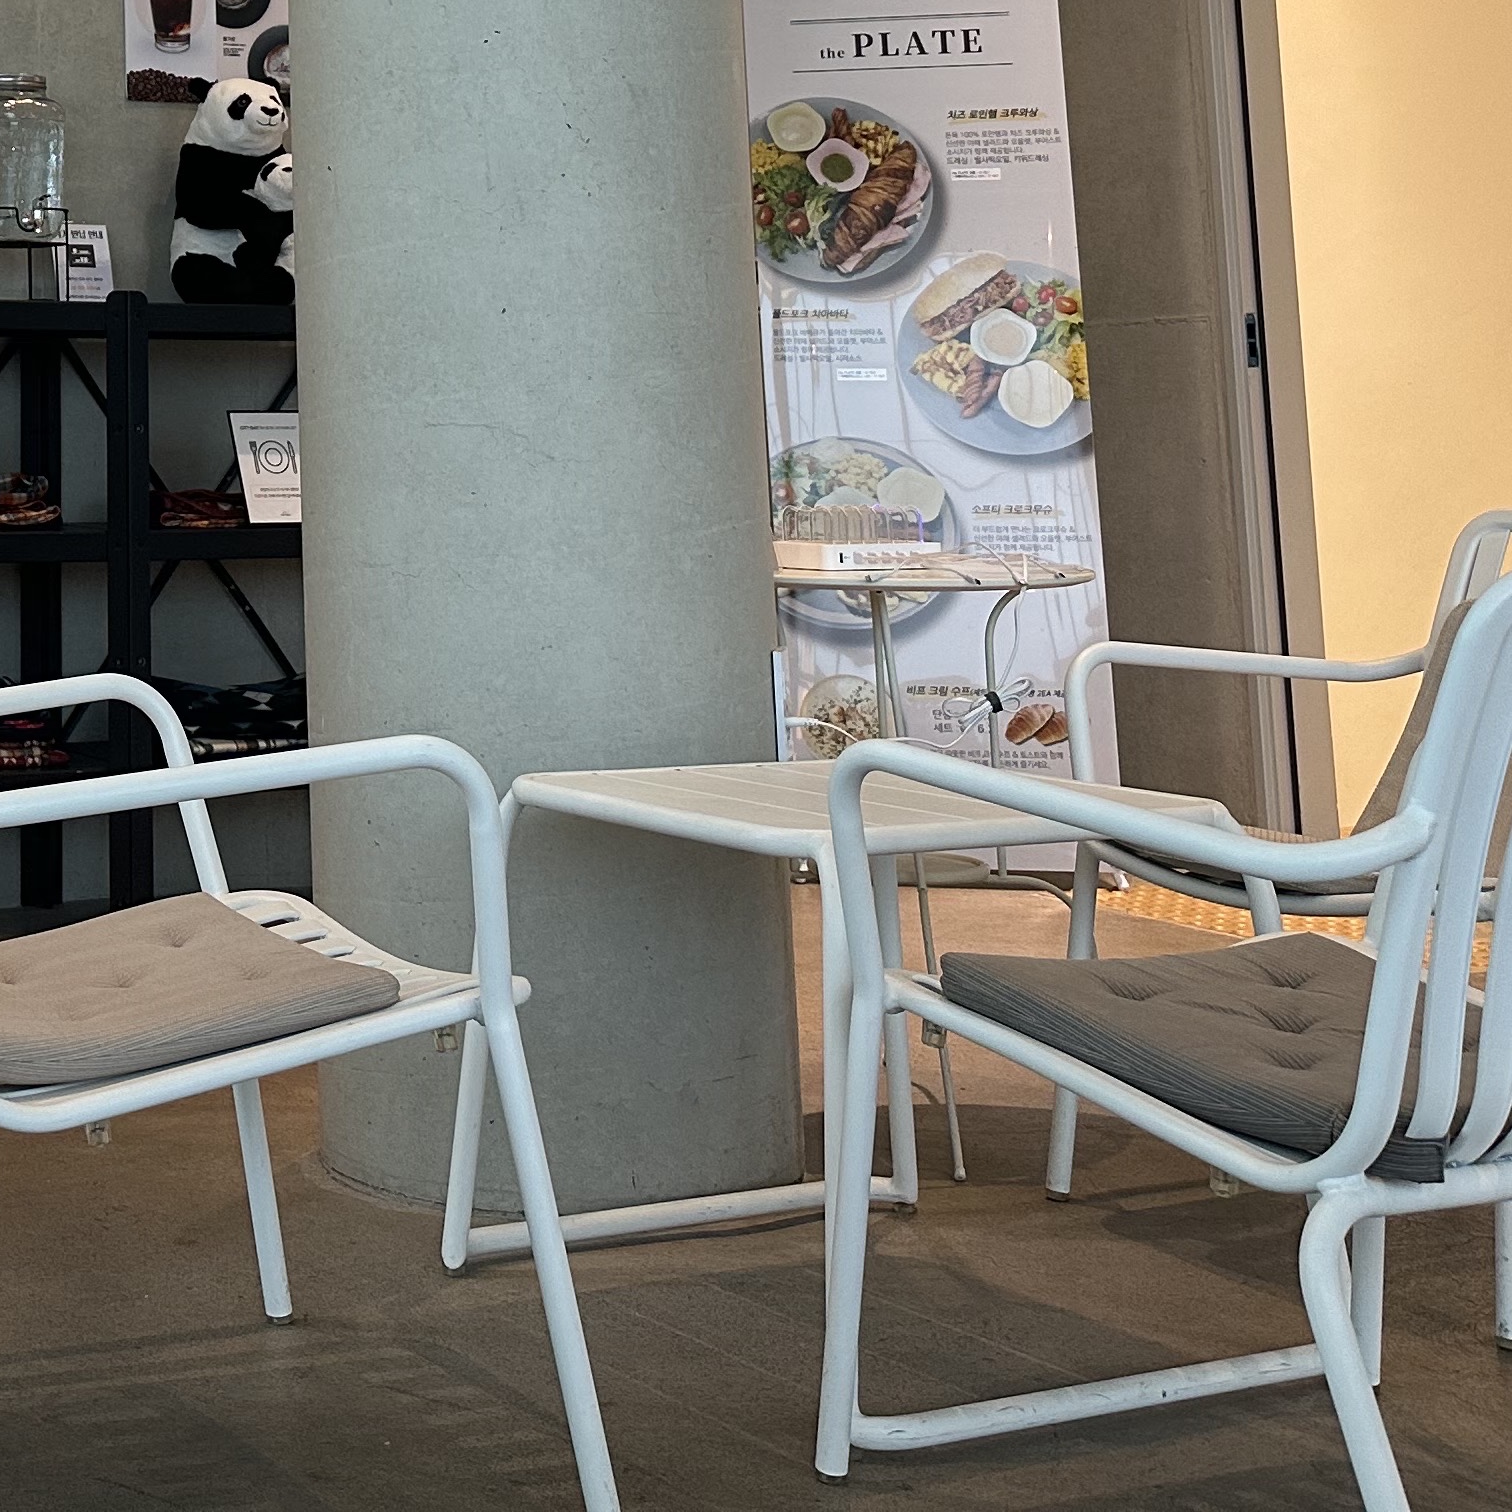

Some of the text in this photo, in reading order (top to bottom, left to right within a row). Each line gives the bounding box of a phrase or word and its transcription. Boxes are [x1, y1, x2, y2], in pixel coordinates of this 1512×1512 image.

[819, 28, 984, 60] the PLATE
[947, 110, 966, 119] 치즈
[1000, 107, 1038, 118] 크루와상
[972, 504, 1052, 515] 소프티 크로크무슈
[906, 686, 925, 696] 비프
[928, 686, 948, 696] 크림
[934, 723, 953, 732] 세트
